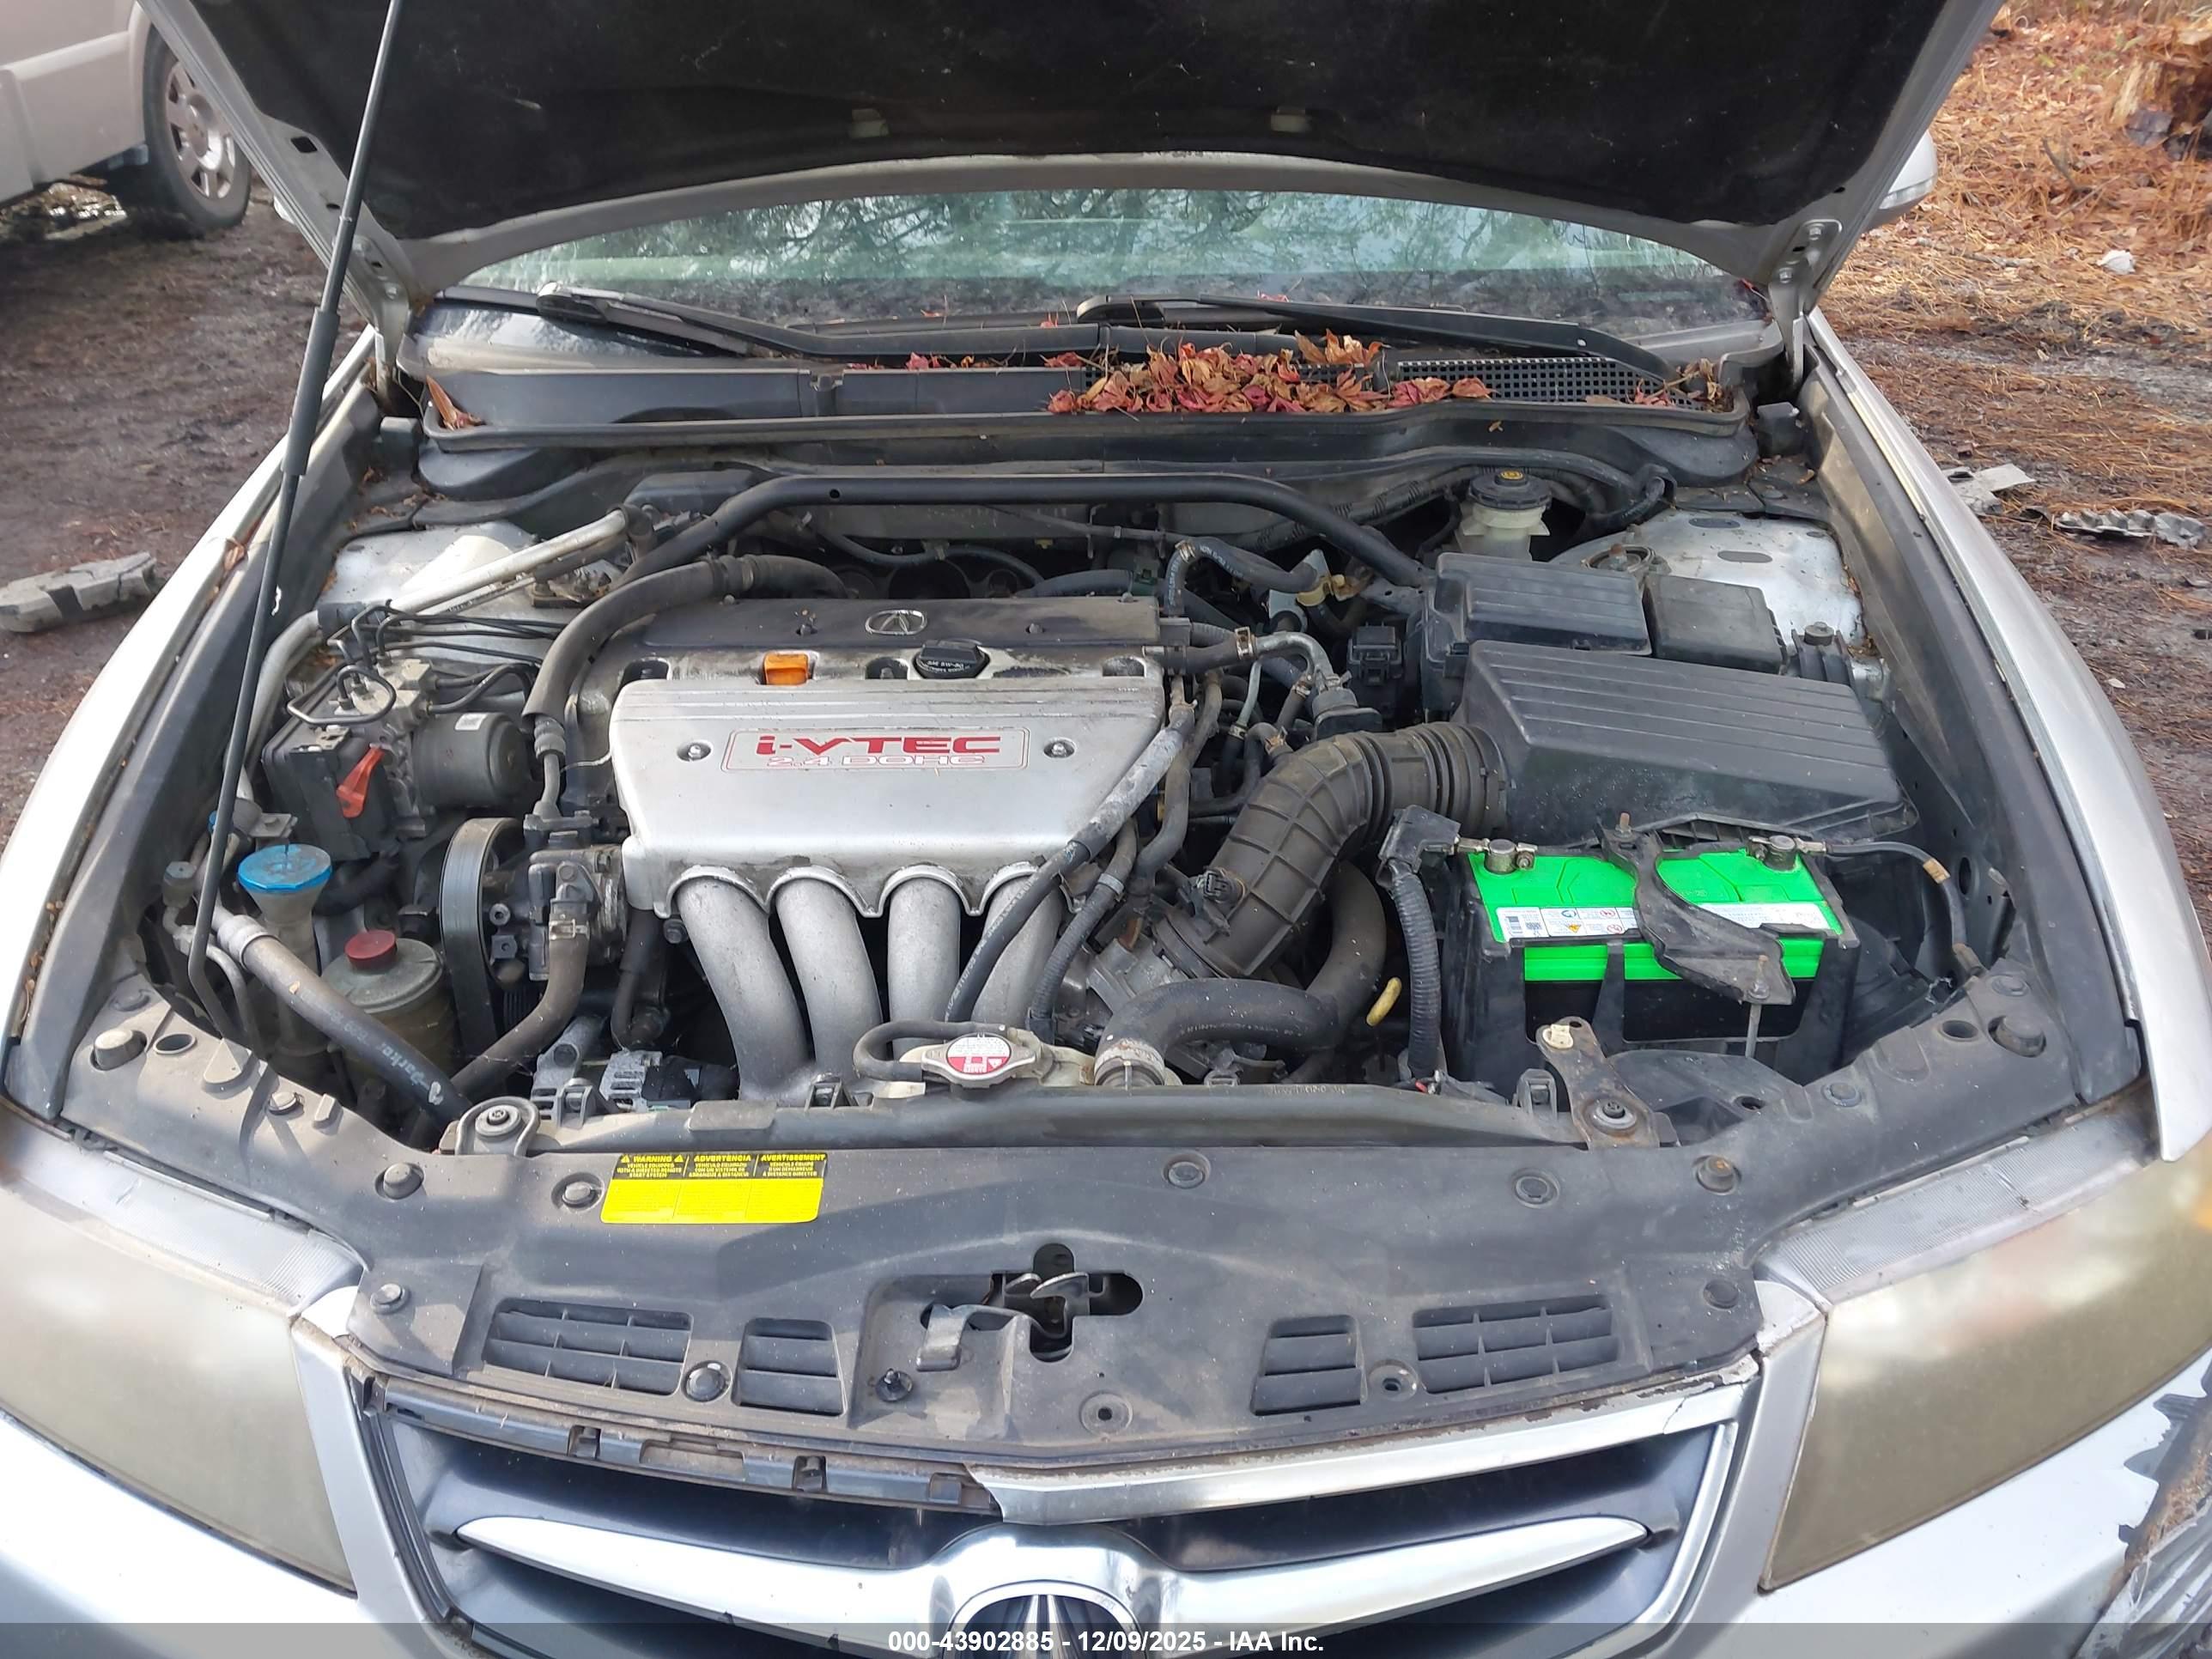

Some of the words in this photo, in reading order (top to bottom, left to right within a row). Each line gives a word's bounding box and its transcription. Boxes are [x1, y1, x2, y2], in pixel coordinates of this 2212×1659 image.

[756, 735, 1001, 755] i-VTEC
[767, 756, 830, 767] 2.4
[841, 755, 986, 766] DOHC
[633, 1154, 672, 1163] WARNING
[761, 1153, 826, 1162] AVERTISSEMENT
